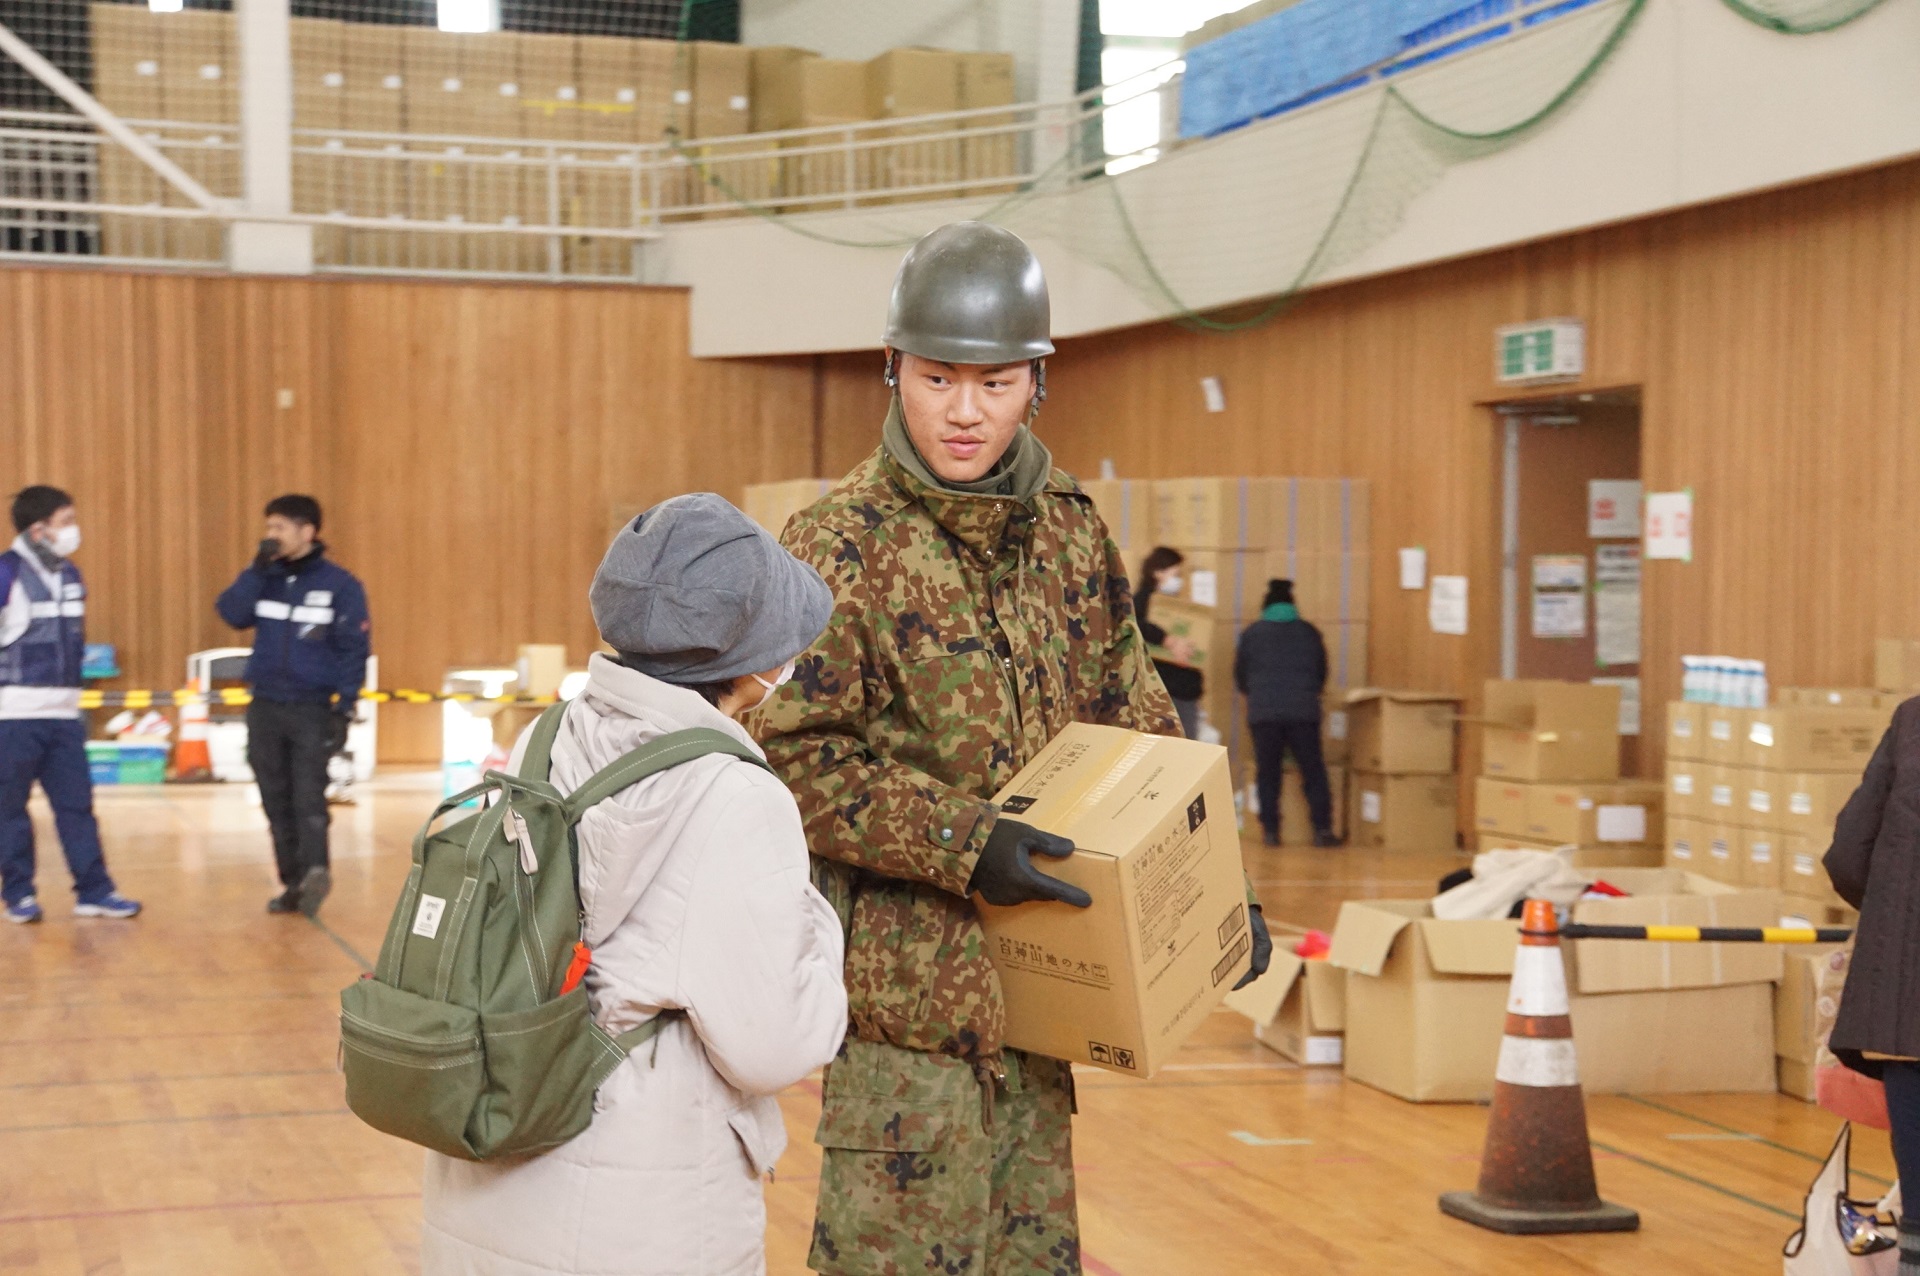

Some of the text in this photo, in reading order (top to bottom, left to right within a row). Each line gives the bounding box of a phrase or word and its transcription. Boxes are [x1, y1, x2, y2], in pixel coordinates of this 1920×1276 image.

[1000, 942, 1090, 974] 白神山地の水
